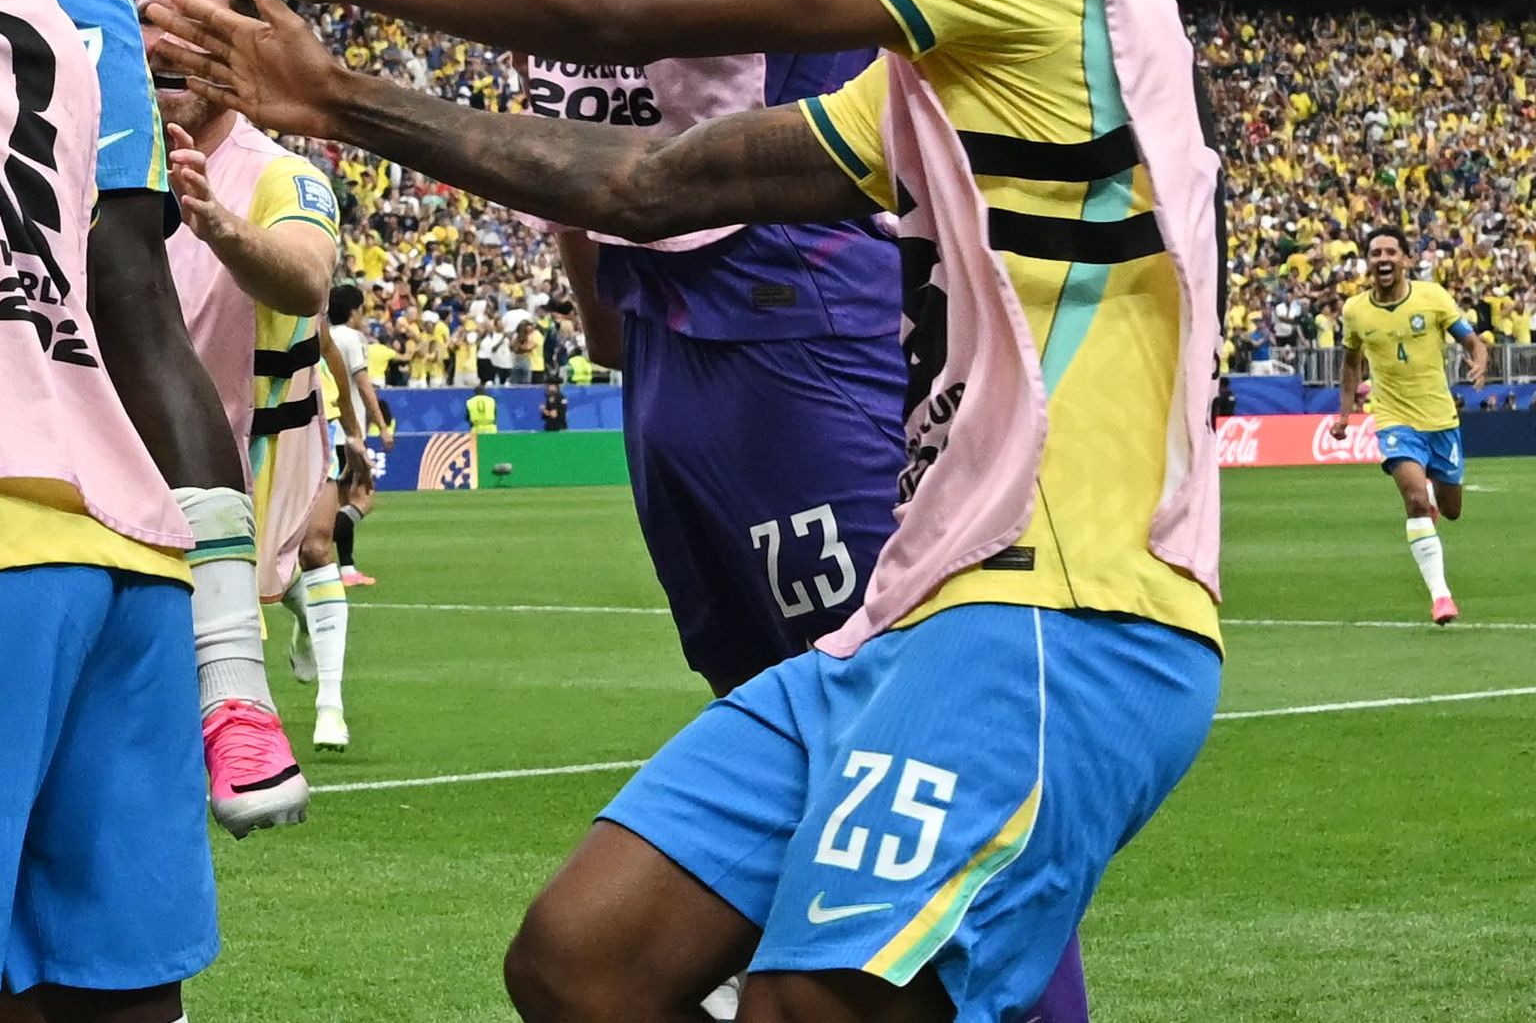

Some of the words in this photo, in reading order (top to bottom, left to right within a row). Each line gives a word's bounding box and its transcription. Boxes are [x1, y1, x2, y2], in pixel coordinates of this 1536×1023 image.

[529, 78, 663, 127] 2026
[1397, 342, 1409, 363] 4
[749, 503, 857, 618] 23
[813, 749, 959, 882] 25
